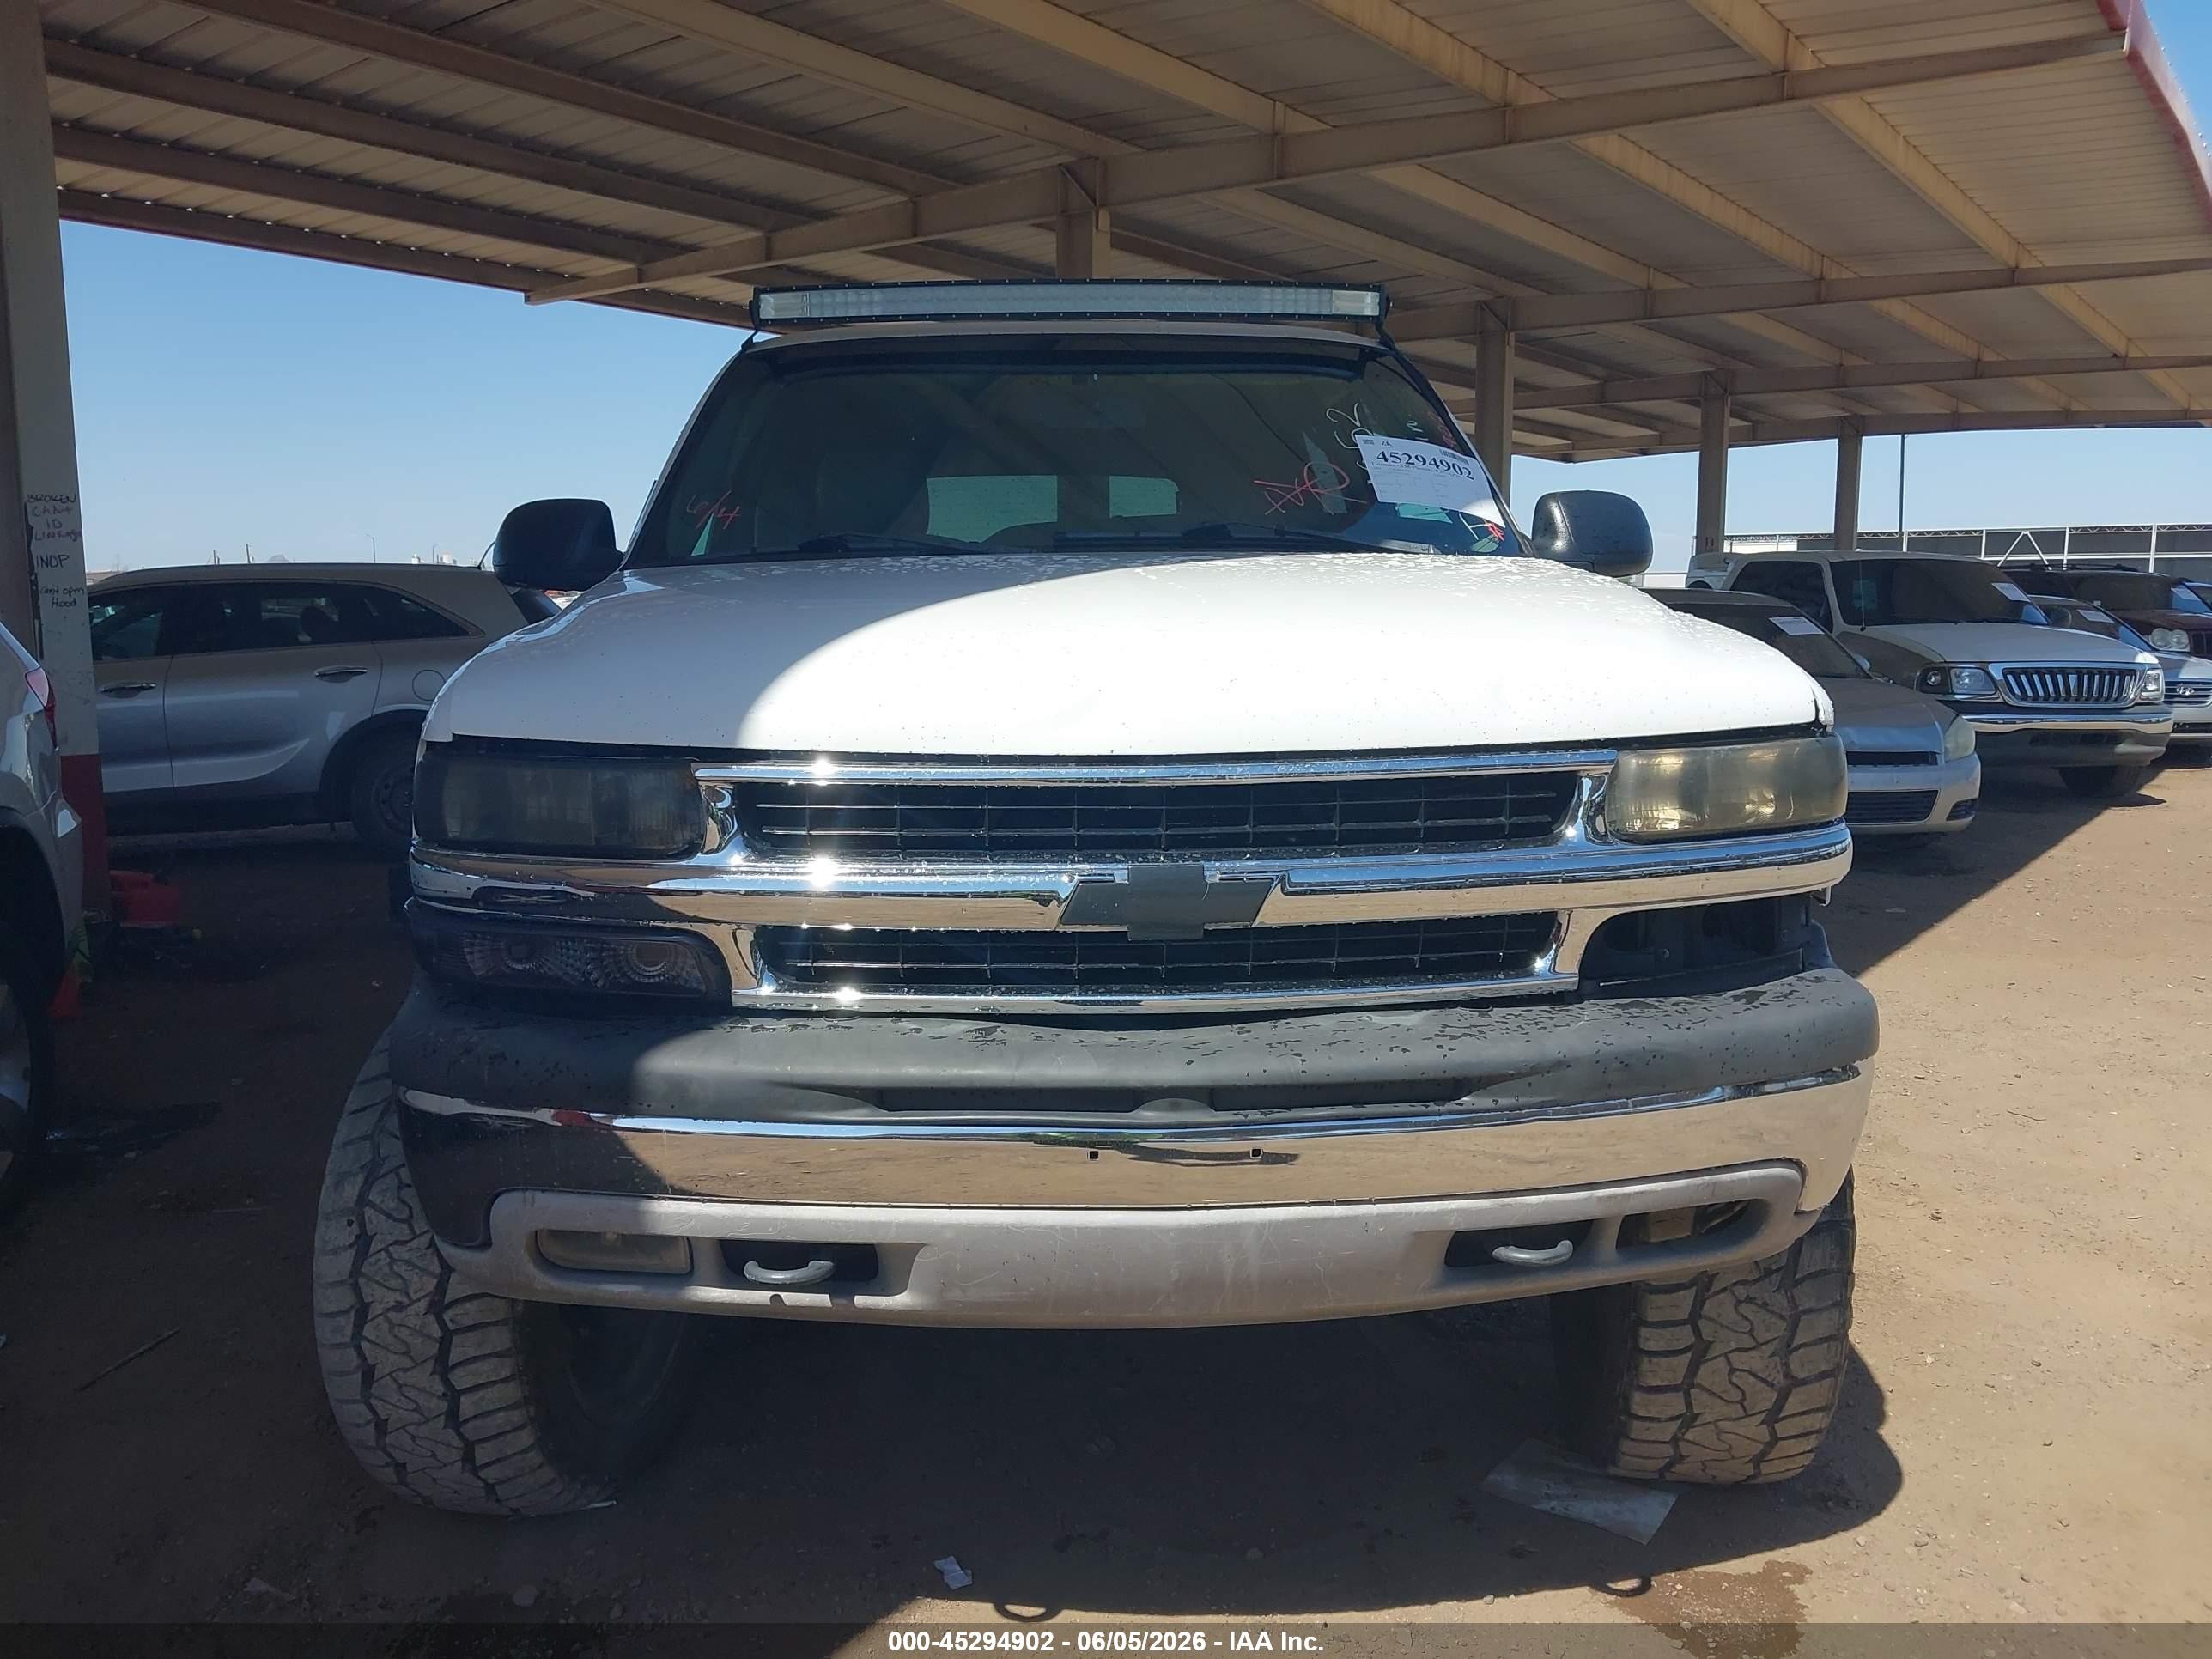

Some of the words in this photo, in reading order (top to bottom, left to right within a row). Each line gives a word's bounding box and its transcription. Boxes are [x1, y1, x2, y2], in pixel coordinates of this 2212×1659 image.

[1376, 450, 1475, 481] 45294902
[27, 493, 77, 504] BROKEN
[36, 554, 70, 568] INOP
[51, 598, 77, 610] Hood
